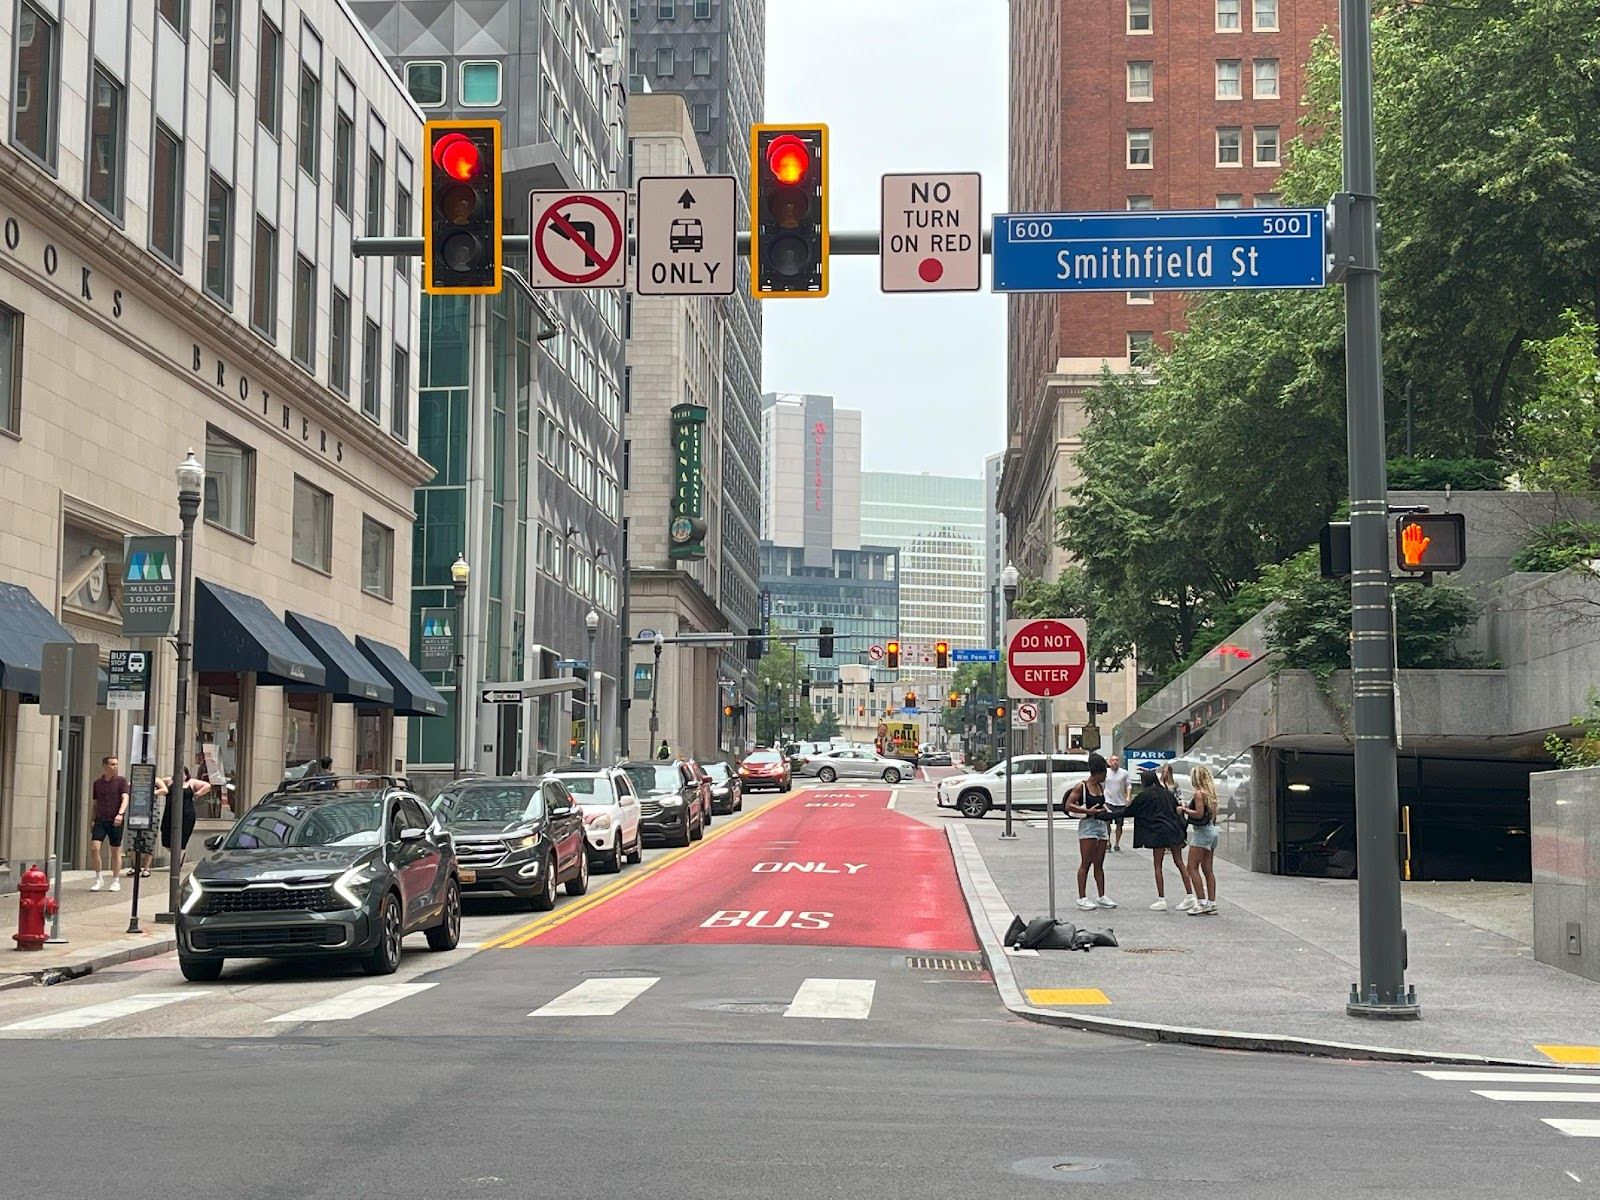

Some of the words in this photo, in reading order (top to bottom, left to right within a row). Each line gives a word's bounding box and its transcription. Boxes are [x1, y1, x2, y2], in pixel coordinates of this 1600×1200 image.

[911, 182, 951, 204] NO
[903, 210, 960, 228] TURN
[1262, 217, 1301, 234] 500
[1015, 222, 1053, 239] 600
[890, 235, 919, 253] ON
[931, 234, 972, 252] RED
[1056, 245, 1213, 281] Smithfield
[1231, 246, 1259, 277] St
[651, 262, 721, 285] ONLY
[193, 343, 344, 463] BROTHERS
[679, 425, 689, 514] MONACO
[1020, 635, 1041, 648] DO
[1043, 635, 1072, 648] NOT
[110, 651, 127, 660] BUS
[1024, 669, 1070, 682] ENTER
[893, 729, 917, 741] CALL
[1132, 751, 1166, 759] PARK
[751, 861, 868, 875] ONLY
[699, 910, 835, 930] BUS
